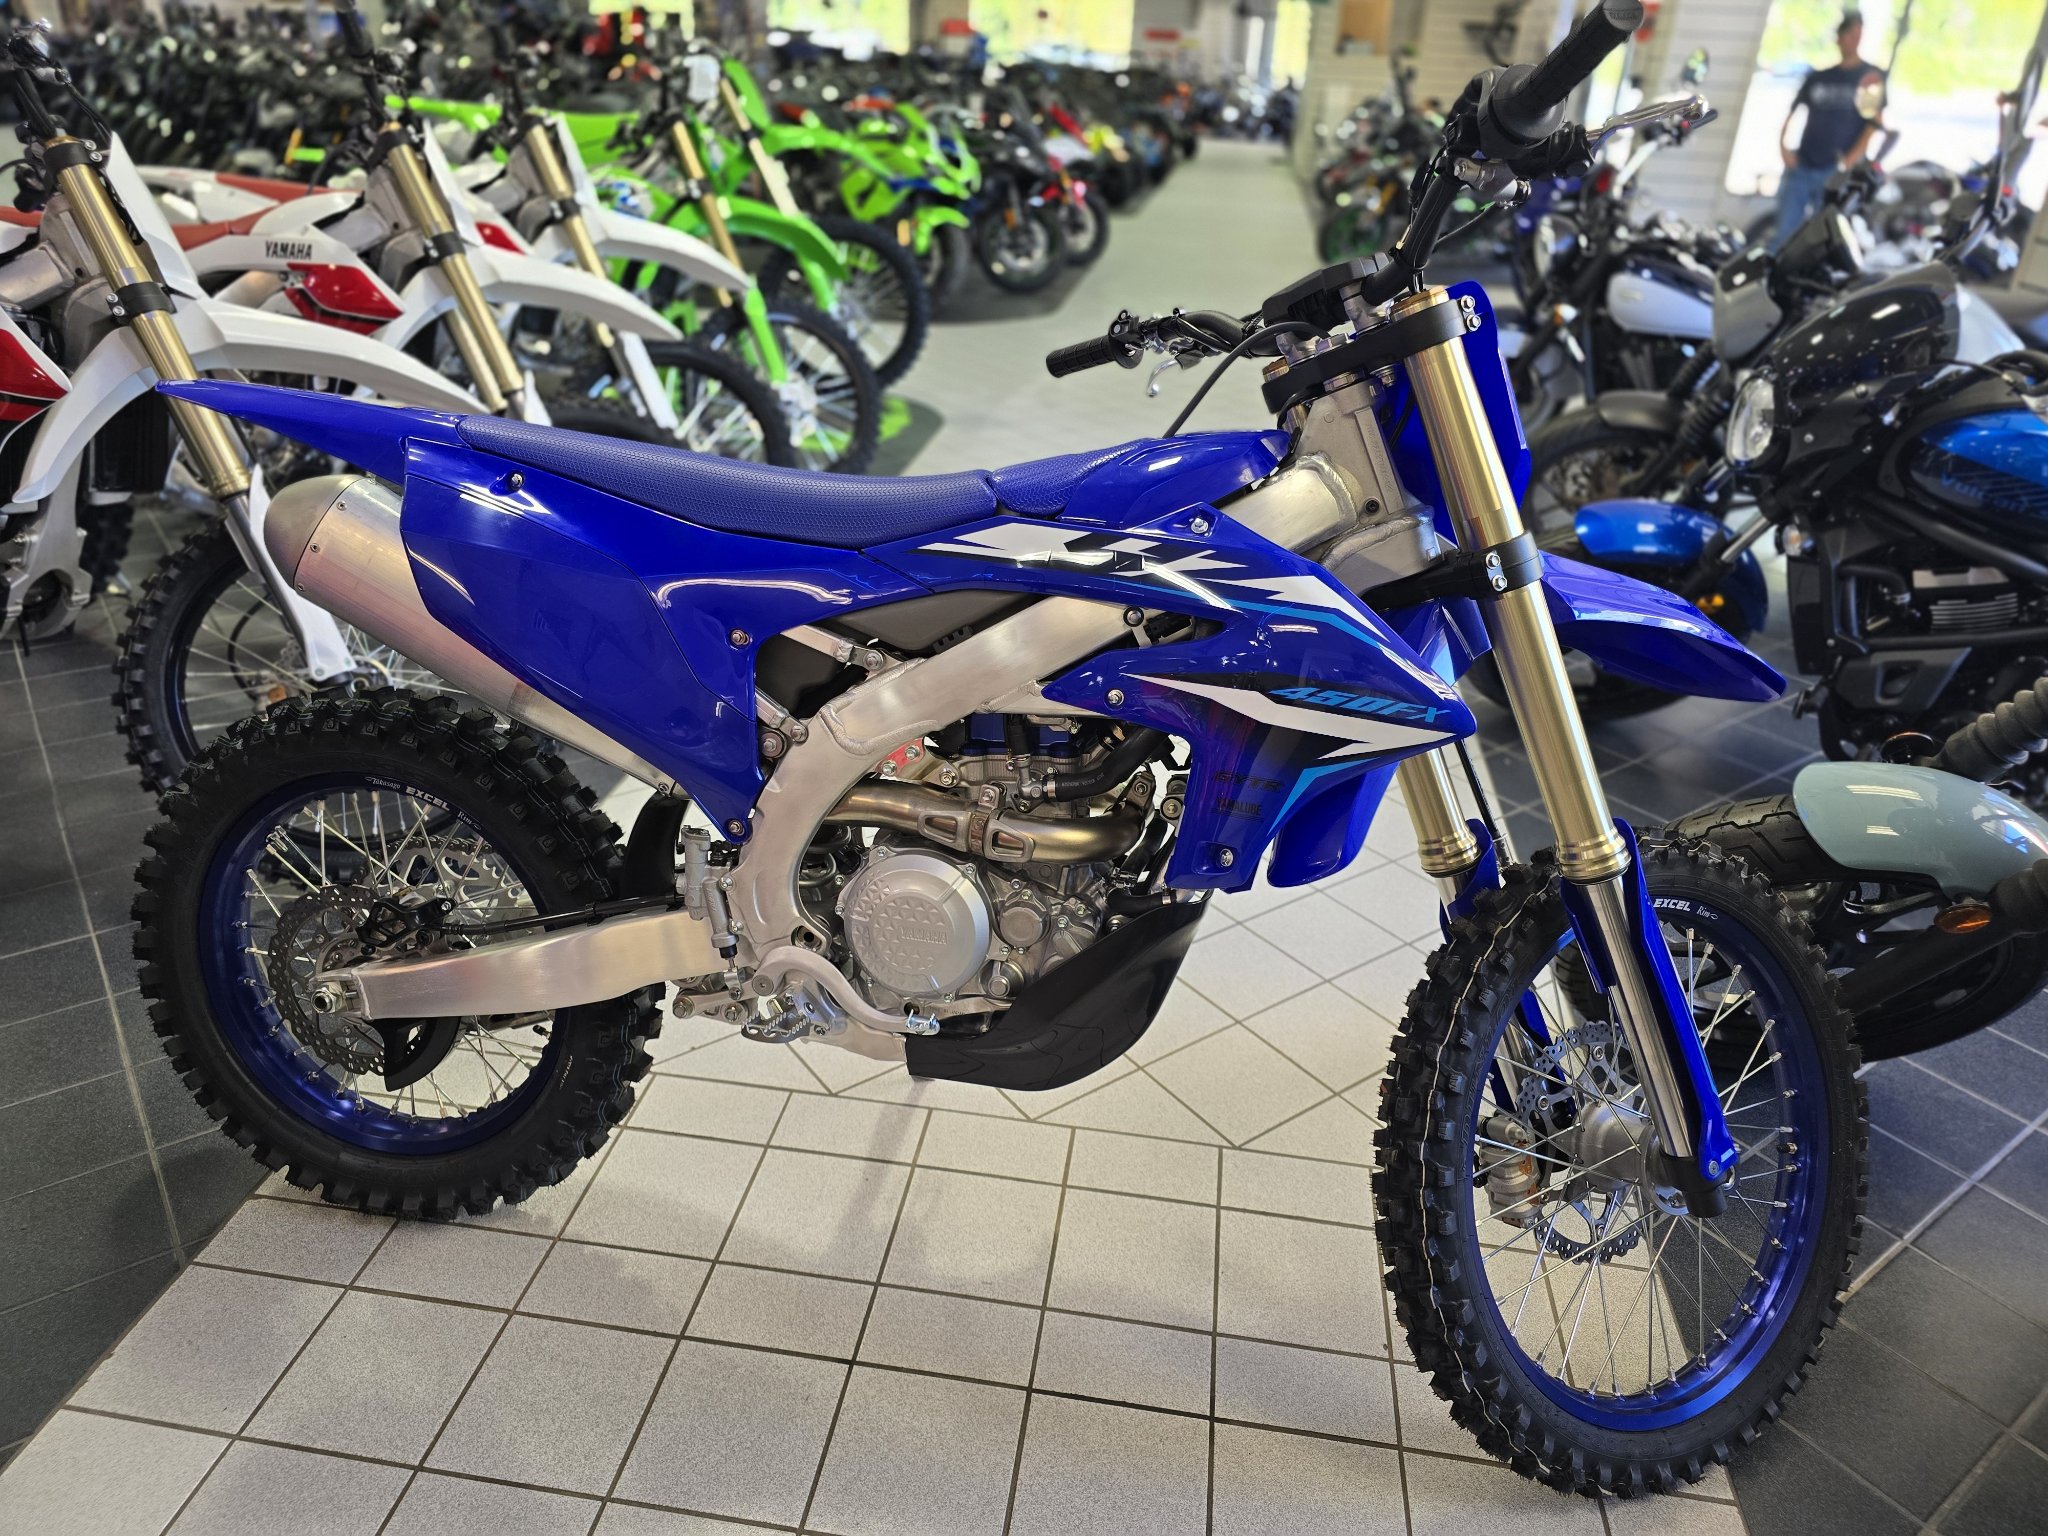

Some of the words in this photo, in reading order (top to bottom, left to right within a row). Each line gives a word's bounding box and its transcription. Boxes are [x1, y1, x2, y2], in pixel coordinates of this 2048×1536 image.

[265, 240, 312, 260] YAMAHA
[1268, 687, 1451, 723] 450FX
[367, 777, 401, 790] Takasago
[405, 786, 450, 811] EXCEL
[457, 811, 473, 825] Rim
[1216, 796, 1262, 816] YAMALUBE
[1653, 898, 1691, 912] EXCEL
[1696, 905, 1711, 918] Rim
[900, 927, 948, 945] YAMAHA
